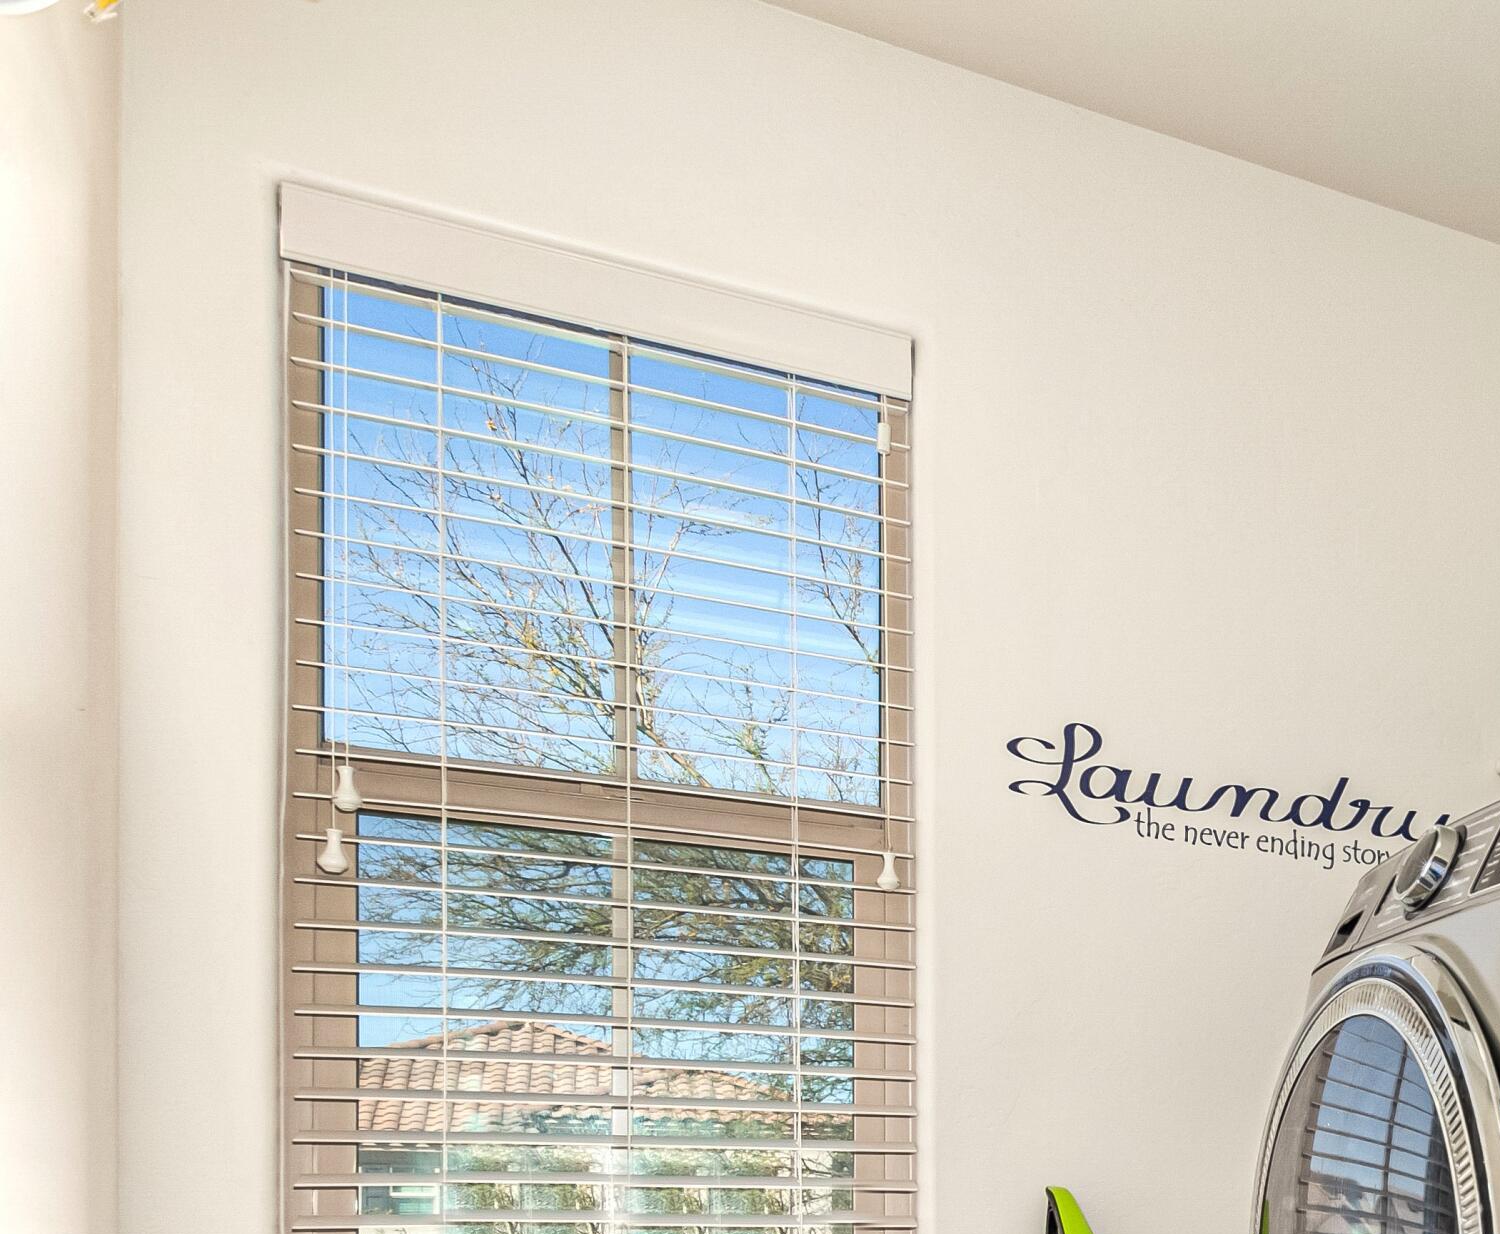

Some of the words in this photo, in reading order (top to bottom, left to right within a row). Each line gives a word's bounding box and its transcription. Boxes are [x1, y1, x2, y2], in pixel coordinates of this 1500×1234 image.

[1135, 808, 1175, 842] the
[1184, 824, 1250, 850] never
[1256, 829, 1336, 870] ending
